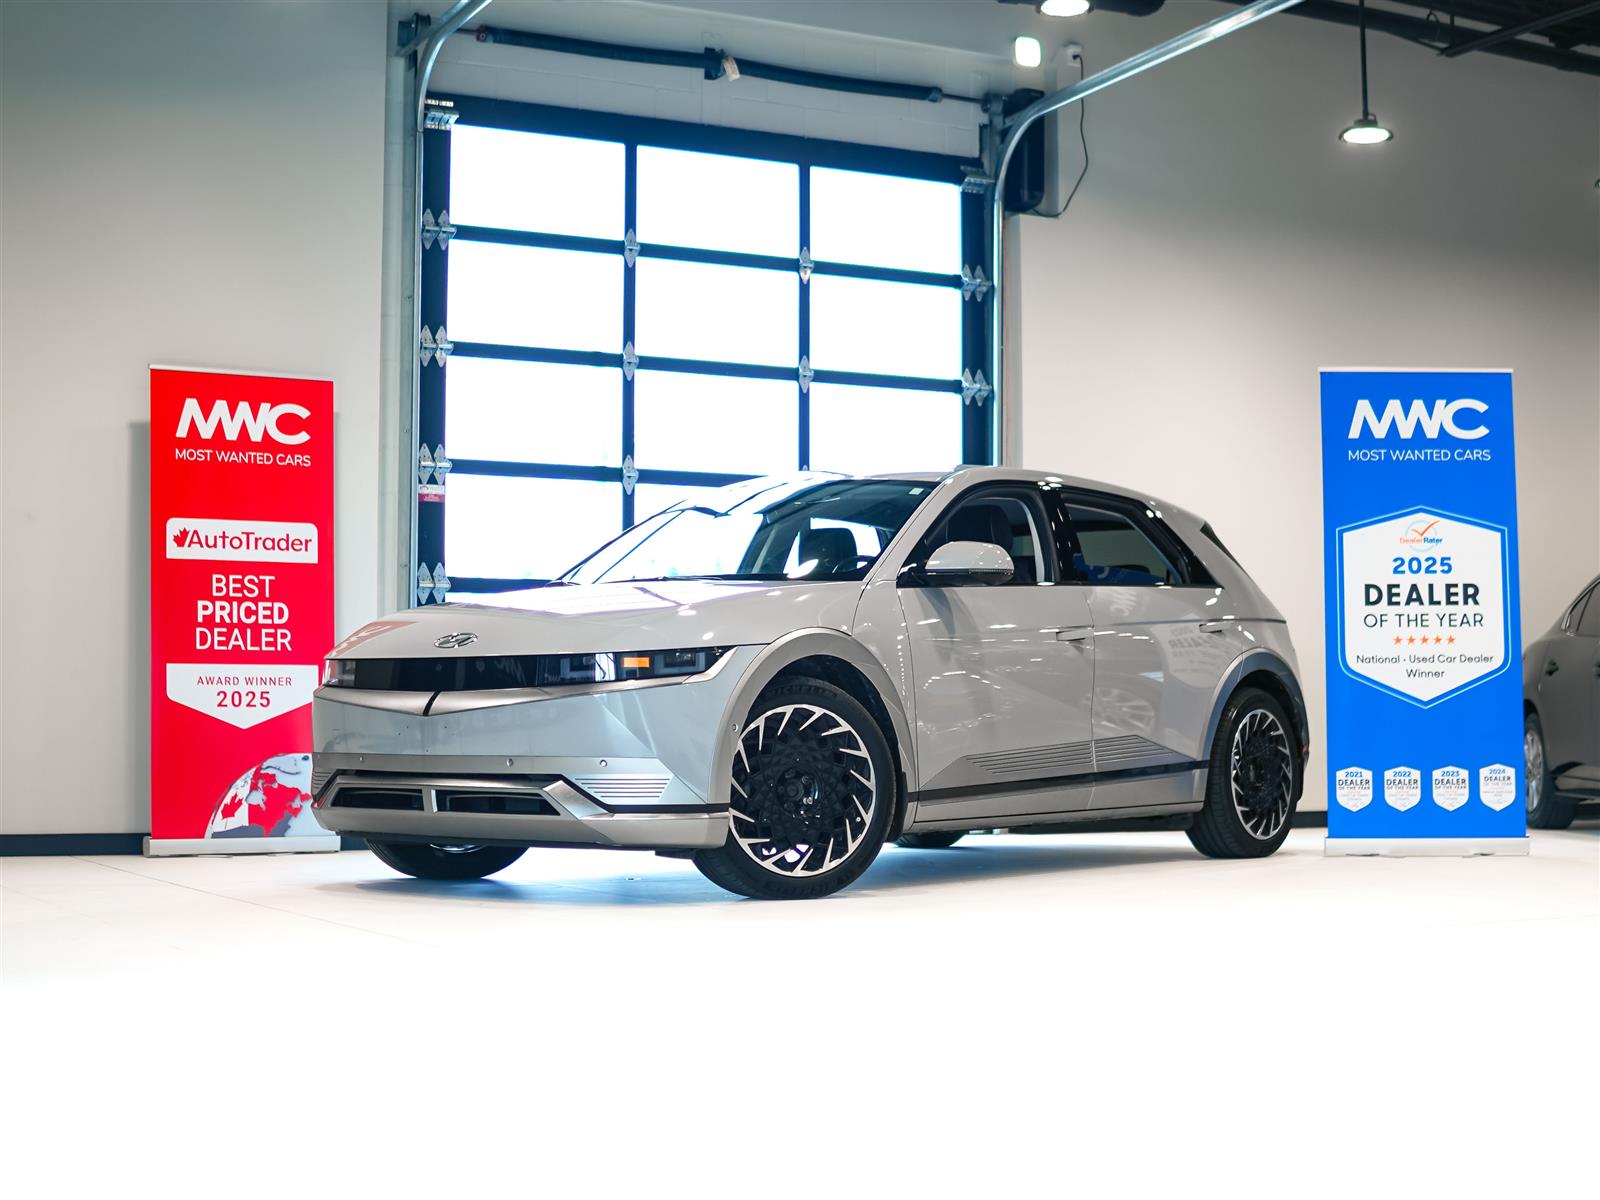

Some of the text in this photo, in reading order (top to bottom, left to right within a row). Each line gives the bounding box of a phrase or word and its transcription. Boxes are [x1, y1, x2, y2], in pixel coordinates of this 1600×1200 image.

[175, 397, 312, 445] MWC
[1347, 398, 1490, 440] MWC
[175, 448, 311, 467] MOST WANTED CARS
[1348, 449, 1491, 461] MOST WANTED CARS
[187, 529, 312, 553] AutoTrader
[1392, 556, 1453, 575] 2025
[211, 573, 276, 598] BEST
[1364, 583, 1480, 606] DEALER
[196, 600, 289, 625] PRICED
[1363, 613, 1484, 628] OF THE YEAR
[195, 627, 292, 651] DEALER
[1356, 654, 1400, 664] National
[1409, 654, 1435, 664] Used
[1437, 654, 1457, 664] Car
[1459, 654, 1494, 664] Dealer
[197, 676, 292, 686] AWARD WINNER
[1406, 669, 1445, 678] Winner
[216, 690, 271, 708] 2025
[1392, 770, 1412, 778] 2022
[1434, 778, 1466, 786] DEALER
